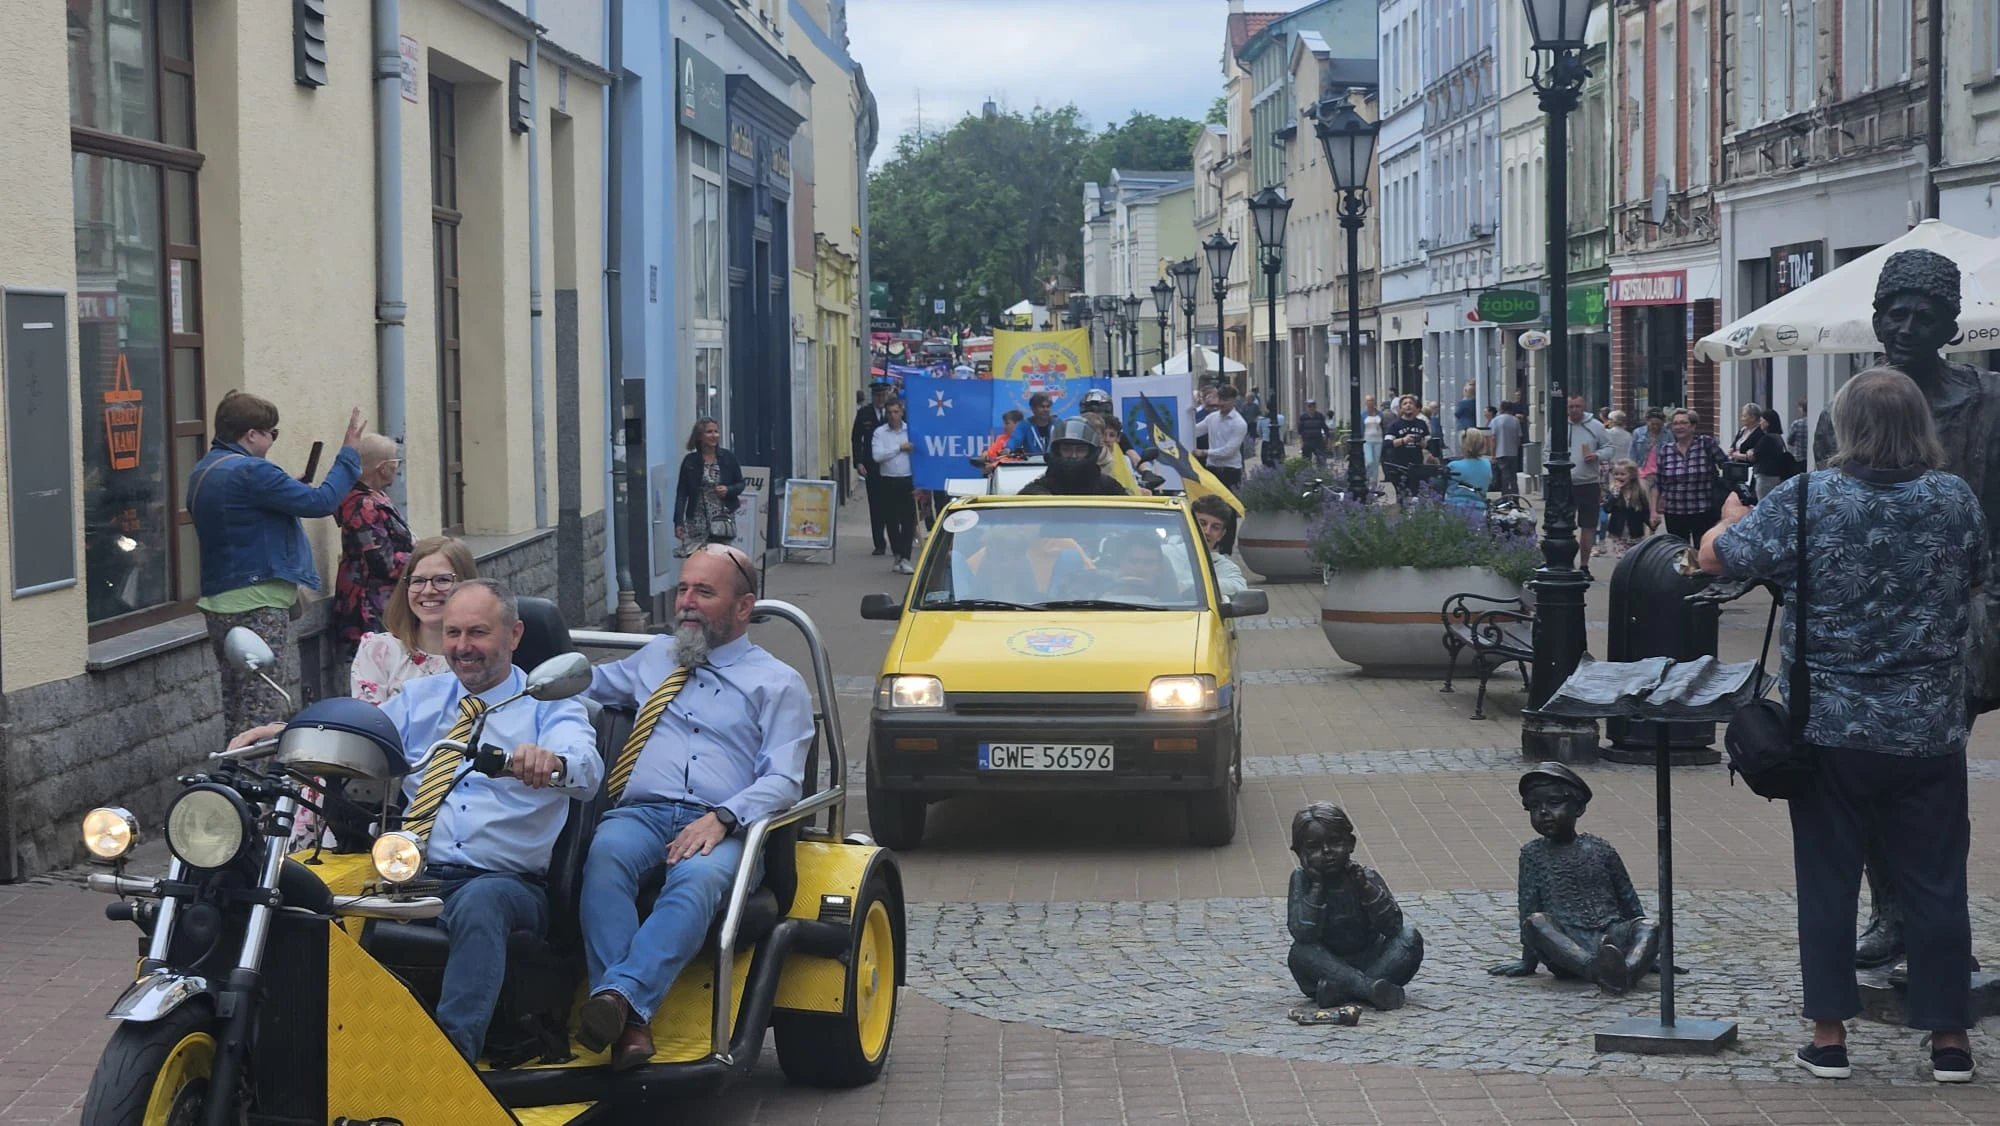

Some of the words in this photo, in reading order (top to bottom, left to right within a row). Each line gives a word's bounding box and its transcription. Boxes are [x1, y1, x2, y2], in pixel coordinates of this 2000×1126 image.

[1482, 298, 1537, 312] żabka
[991, 746, 1035, 768] GWE
[1043, 746, 1111, 769] 56596
